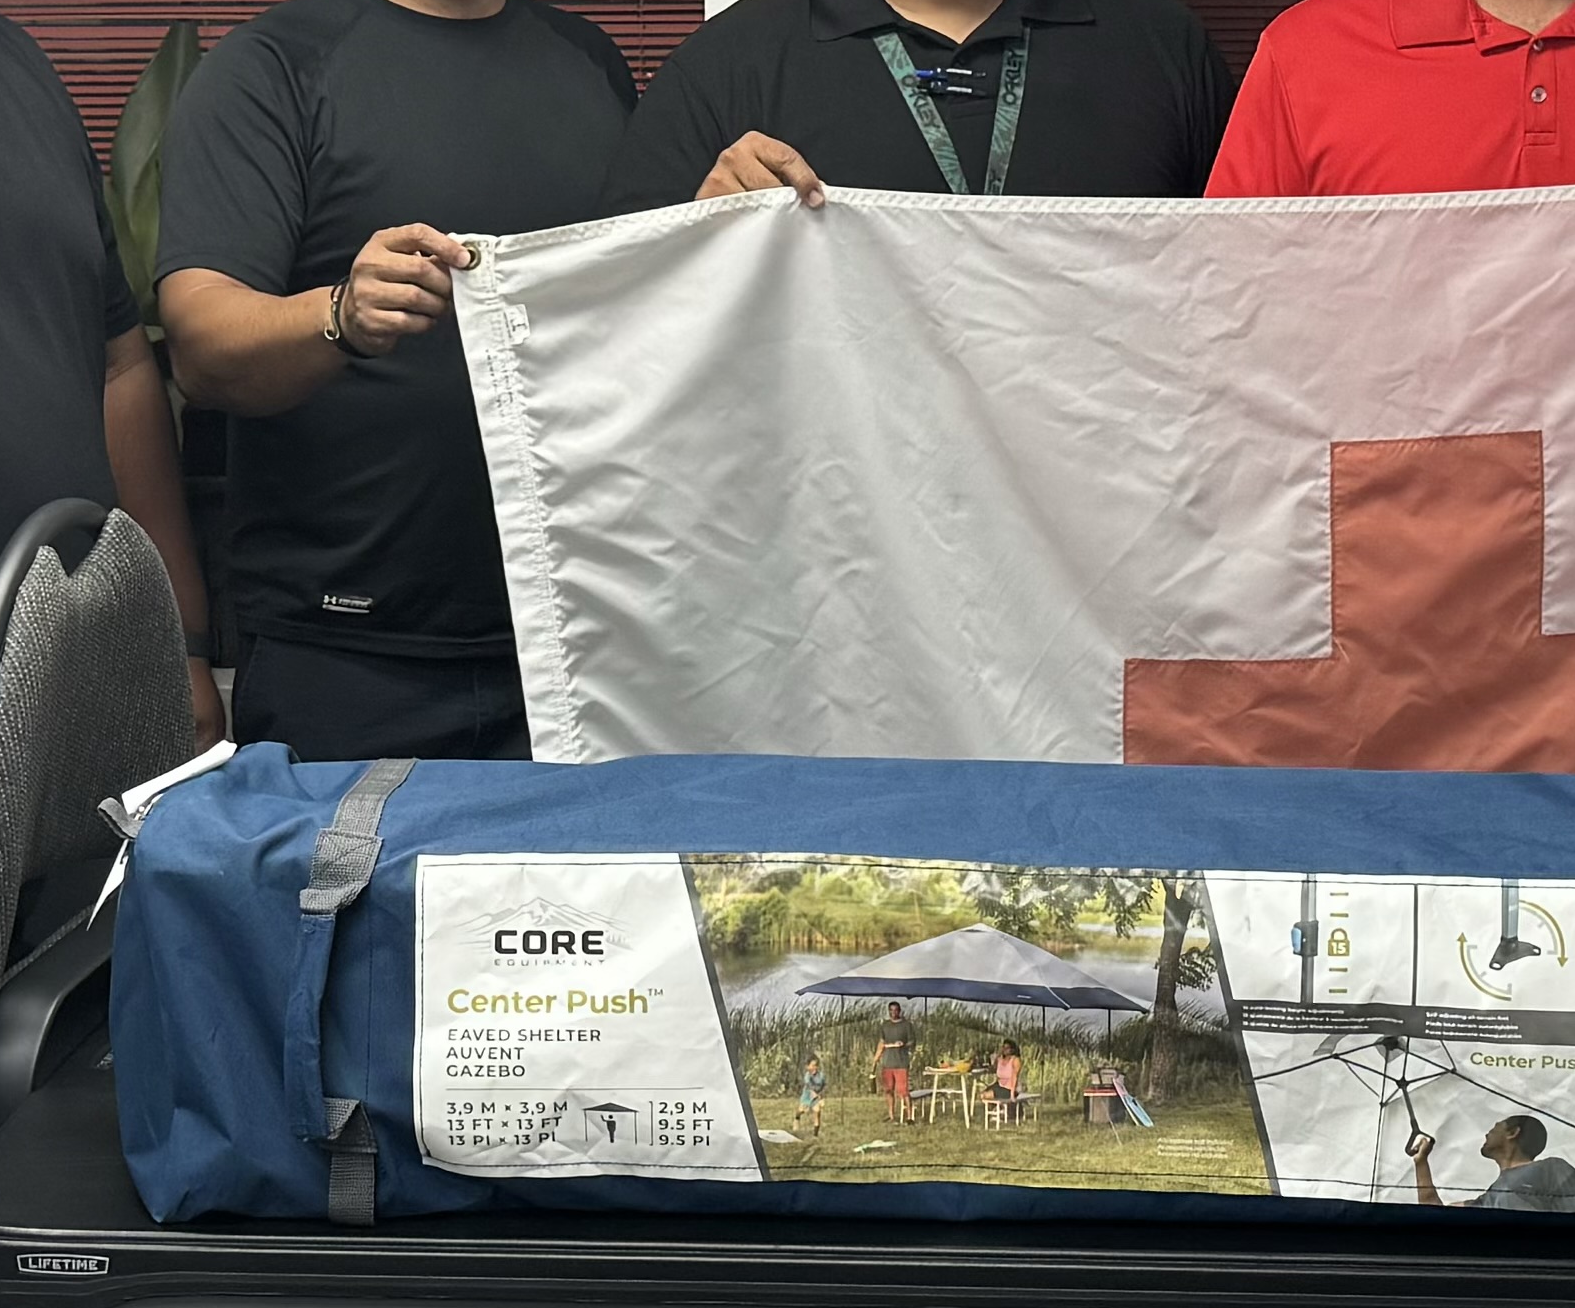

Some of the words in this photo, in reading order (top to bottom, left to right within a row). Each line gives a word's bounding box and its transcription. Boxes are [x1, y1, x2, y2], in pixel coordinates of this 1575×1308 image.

[494, 930, 605, 955] CORE
[1331, 942, 1347, 954] 15
[447, 989, 557, 1014] Center
[448, 1029, 511, 1042] EAVED
[517, 1029, 602, 1042] SHELTER
[446, 1047, 525, 1060] AUVENT
[1470, 1052, 1536, 1070] Center
[446, 1064, 526, 1078] GAZEBO
[447, 1102, 474, 1116] 3,9
[481, 1102, 496, 1114] M
[519, 1102, 546, 1116] 3,9
[553, 1100, 568, 1113] M
[658, 1102, 685, 1116] 2,9
[692, 1101, 707, 1114] M
[447, 1119, 465, 1131] 13
[472, 1118, 494, 1131] FT
[516, 1118, 534, 1130] 13
[541, 1116, 562, 1128] FT
[658, 1118, 685, 1131] 9.5
[692, 1118, 715, 1131] FT
[448, 1134, 465, 1146] 13
[514, 1133, 532, 1145] 13
[658, 1134, 685, 1146] 9.5
[28, 1257, 99, 1271] LIFETIME
